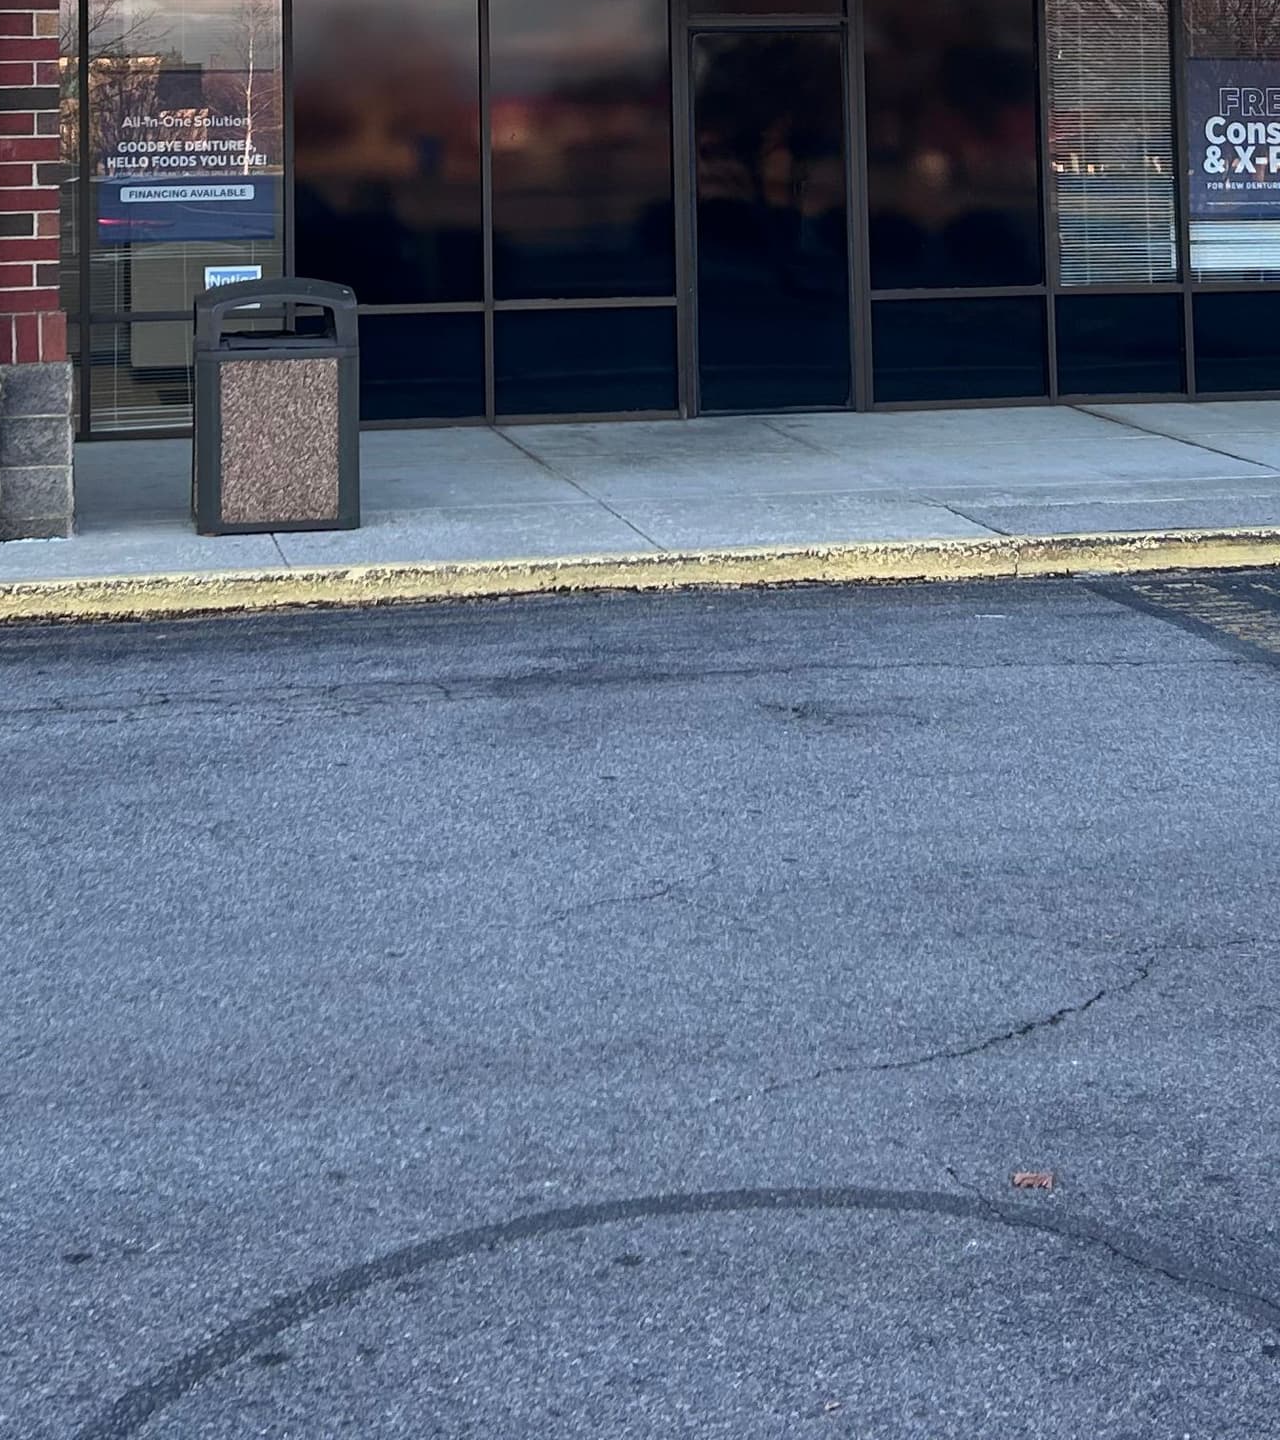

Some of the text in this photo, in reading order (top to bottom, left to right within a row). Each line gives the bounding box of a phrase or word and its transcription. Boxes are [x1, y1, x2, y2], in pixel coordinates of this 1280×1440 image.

[122, 114, 251, 129] All-In-One Solution
[117, 140, 183, 153] GOODBYE
[107, 154, 267, 168] HELLO FOODS YOU LOVE!
[1203, 145, 1225, 174] &
[1207, 182, 1224, 190] FOR
[1225, 182, 1245, 190] NEW
[128, 187, 247, 199] FINANCING AVAILABLE
